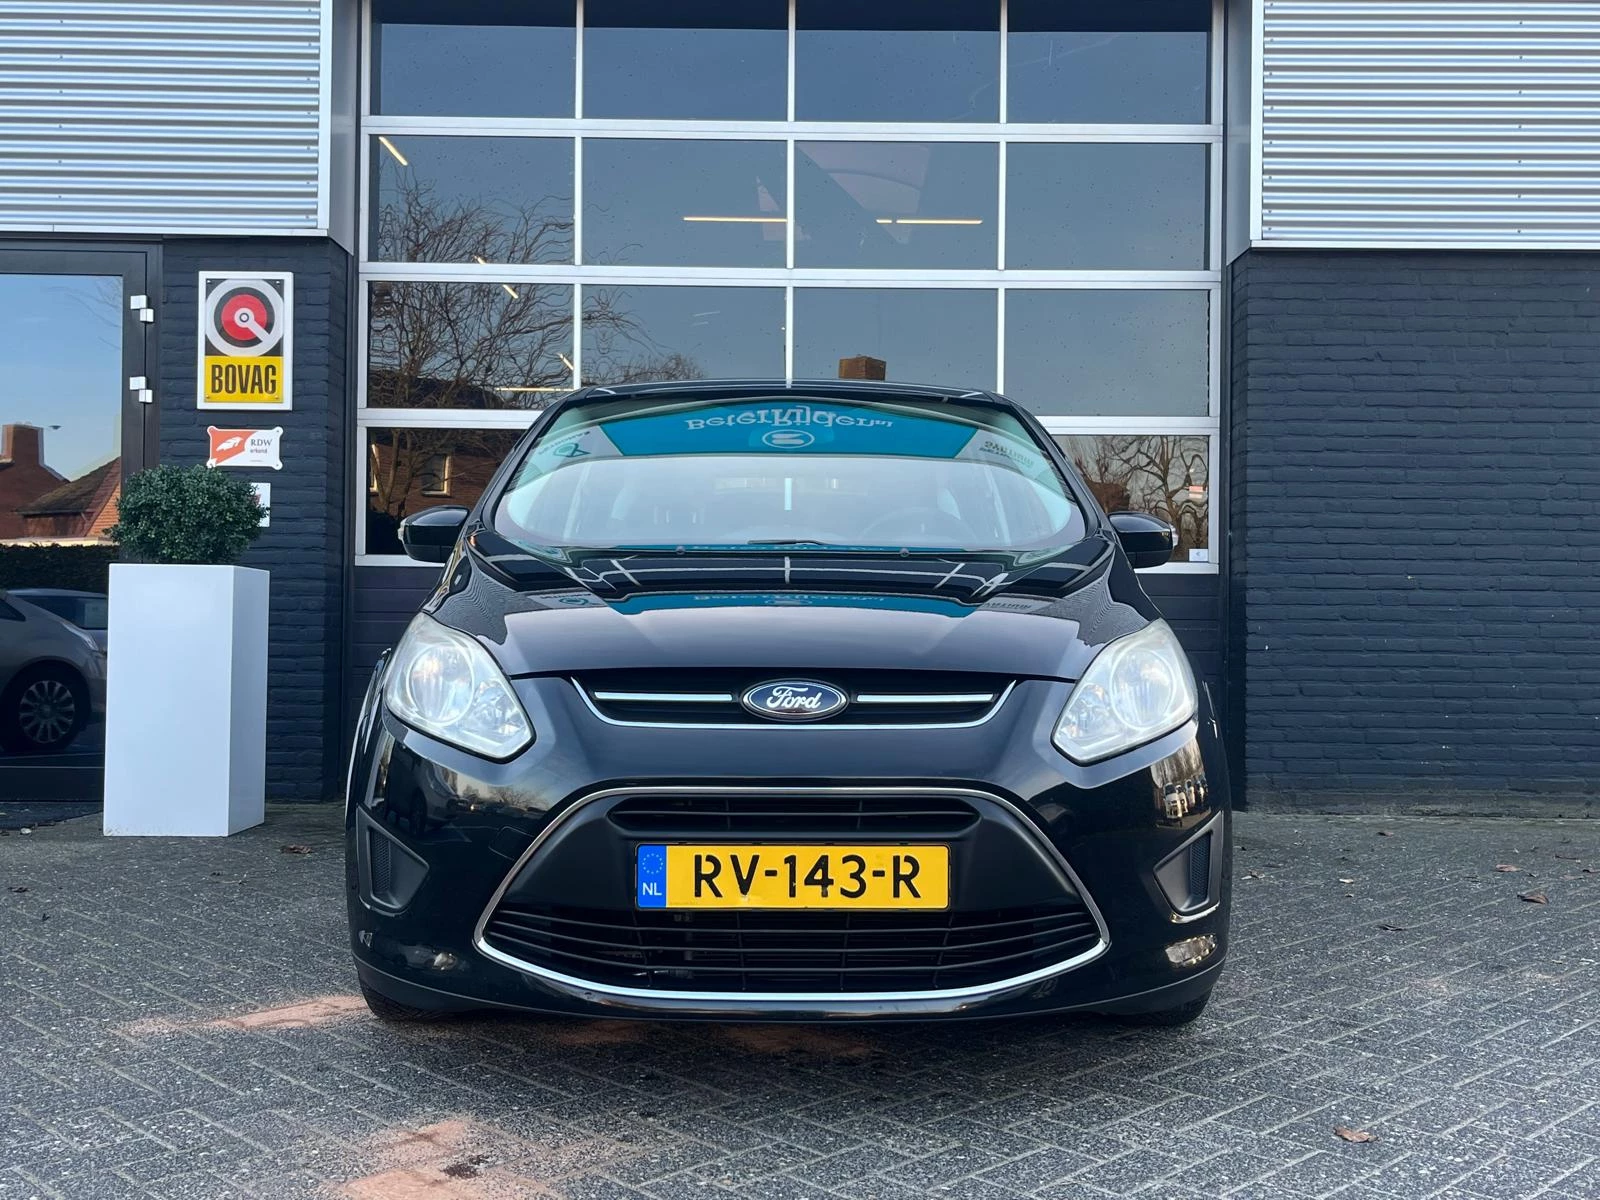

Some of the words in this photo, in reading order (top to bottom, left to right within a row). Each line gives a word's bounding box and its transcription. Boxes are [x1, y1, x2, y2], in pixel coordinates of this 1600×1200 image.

[211, 364, 277, 394] BOVAG
[250, 438, 273, 447] RDW
[766, 685, 822, 709] Ford
[694, 854, 922, 898] RV-143-R
[642, 882, 663, 897] NL
